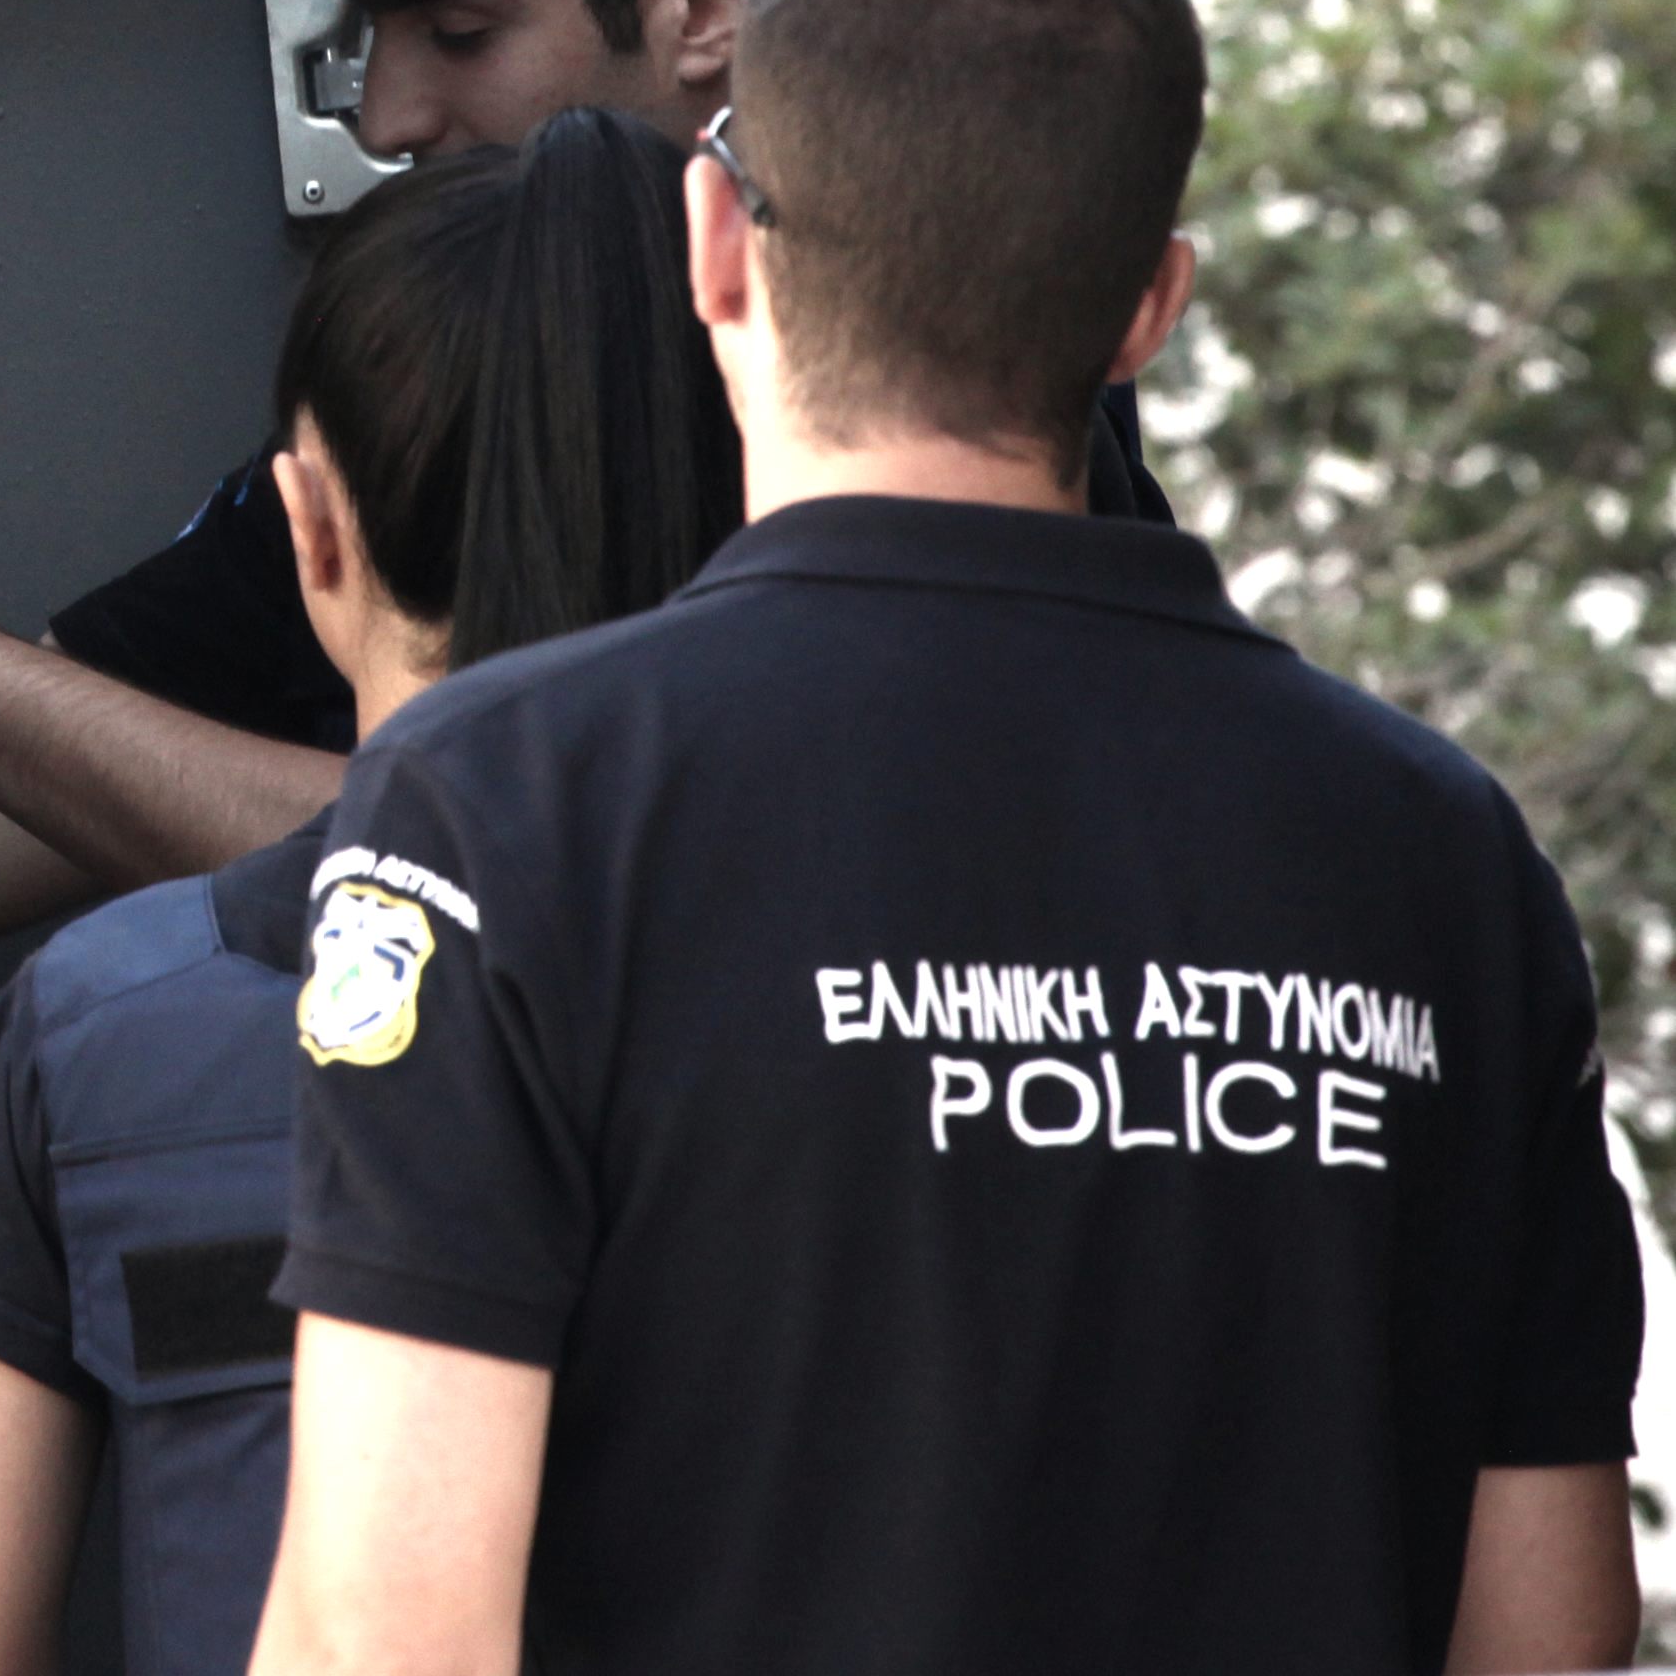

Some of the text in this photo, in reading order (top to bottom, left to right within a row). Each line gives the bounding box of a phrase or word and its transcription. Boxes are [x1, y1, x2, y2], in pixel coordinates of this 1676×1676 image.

[814, 958, 1440, 1082] ΕΛΛΗΝΙΚΗ ΑΣΤΥΝΟΜΙΑ
[929, 1051, 1388, 1170] POLICE
